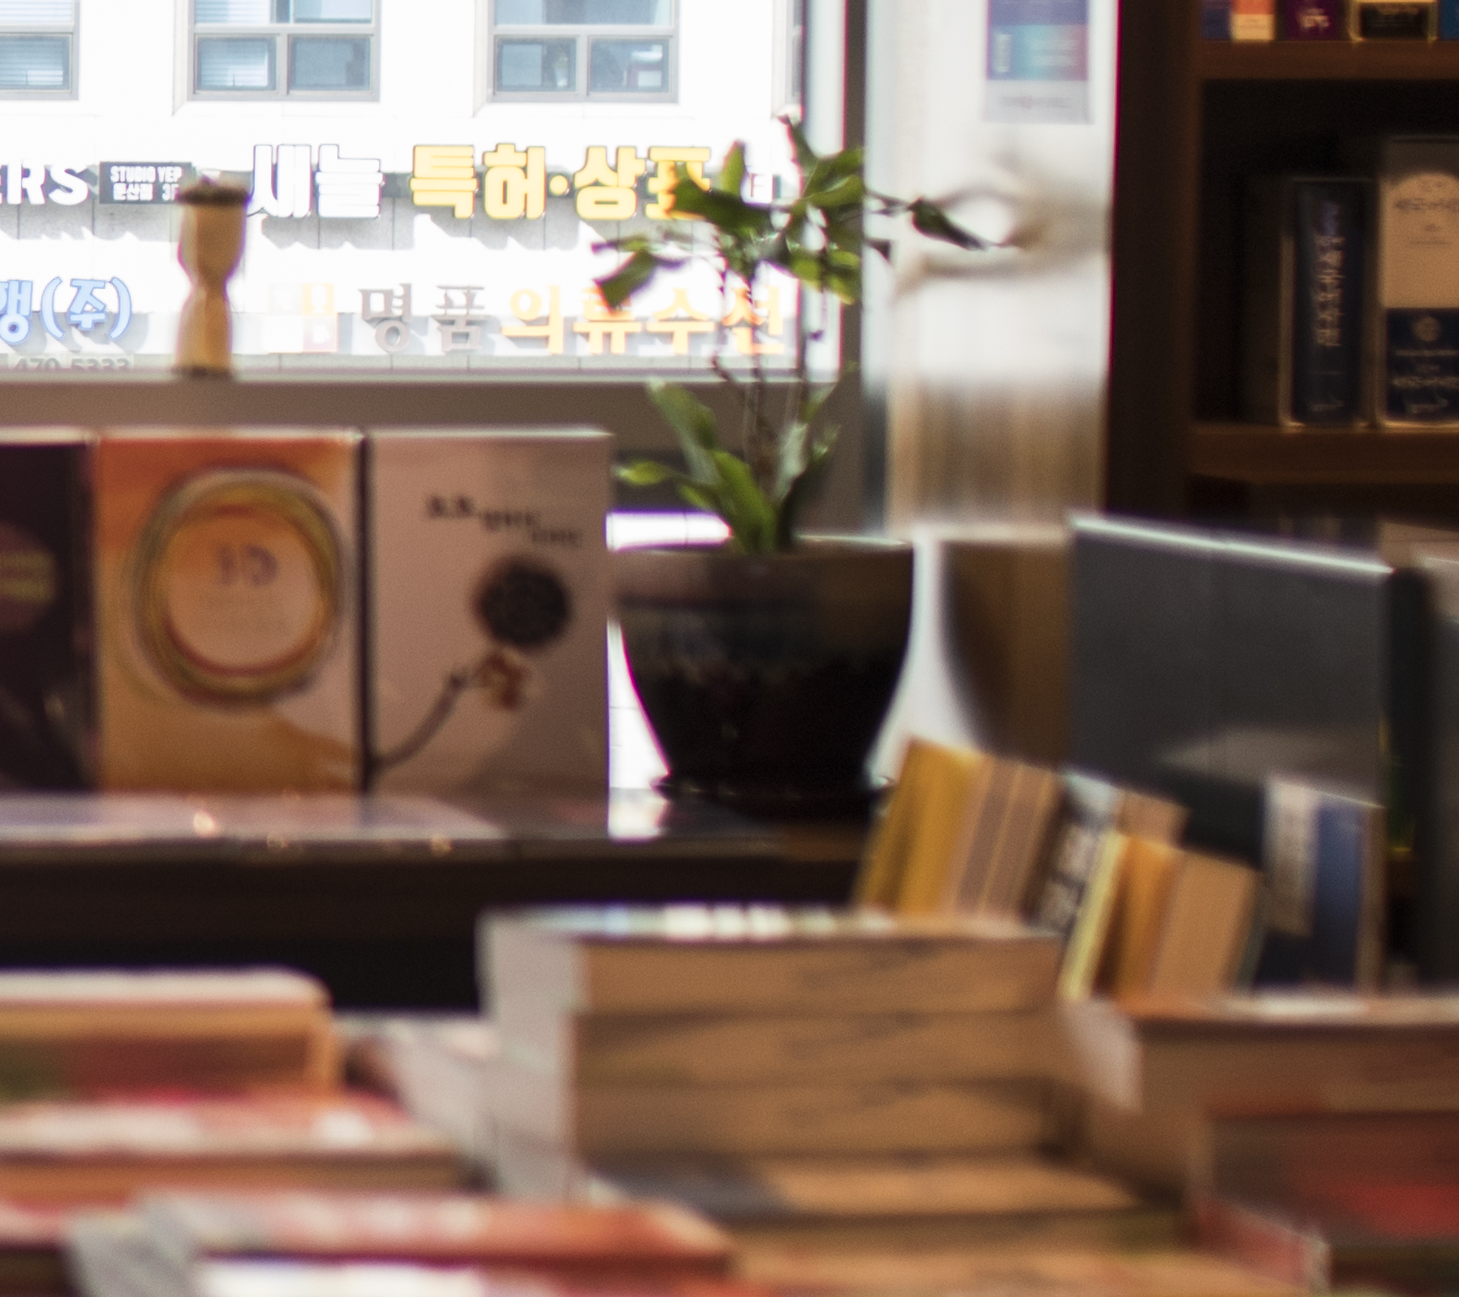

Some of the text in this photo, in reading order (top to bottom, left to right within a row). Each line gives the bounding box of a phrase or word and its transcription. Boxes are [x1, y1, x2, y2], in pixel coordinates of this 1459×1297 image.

[110, 166, 155, 183] STUDIO
[250, 142, 384, 220] 새늘
[357, 283, 486, 353] 명품
